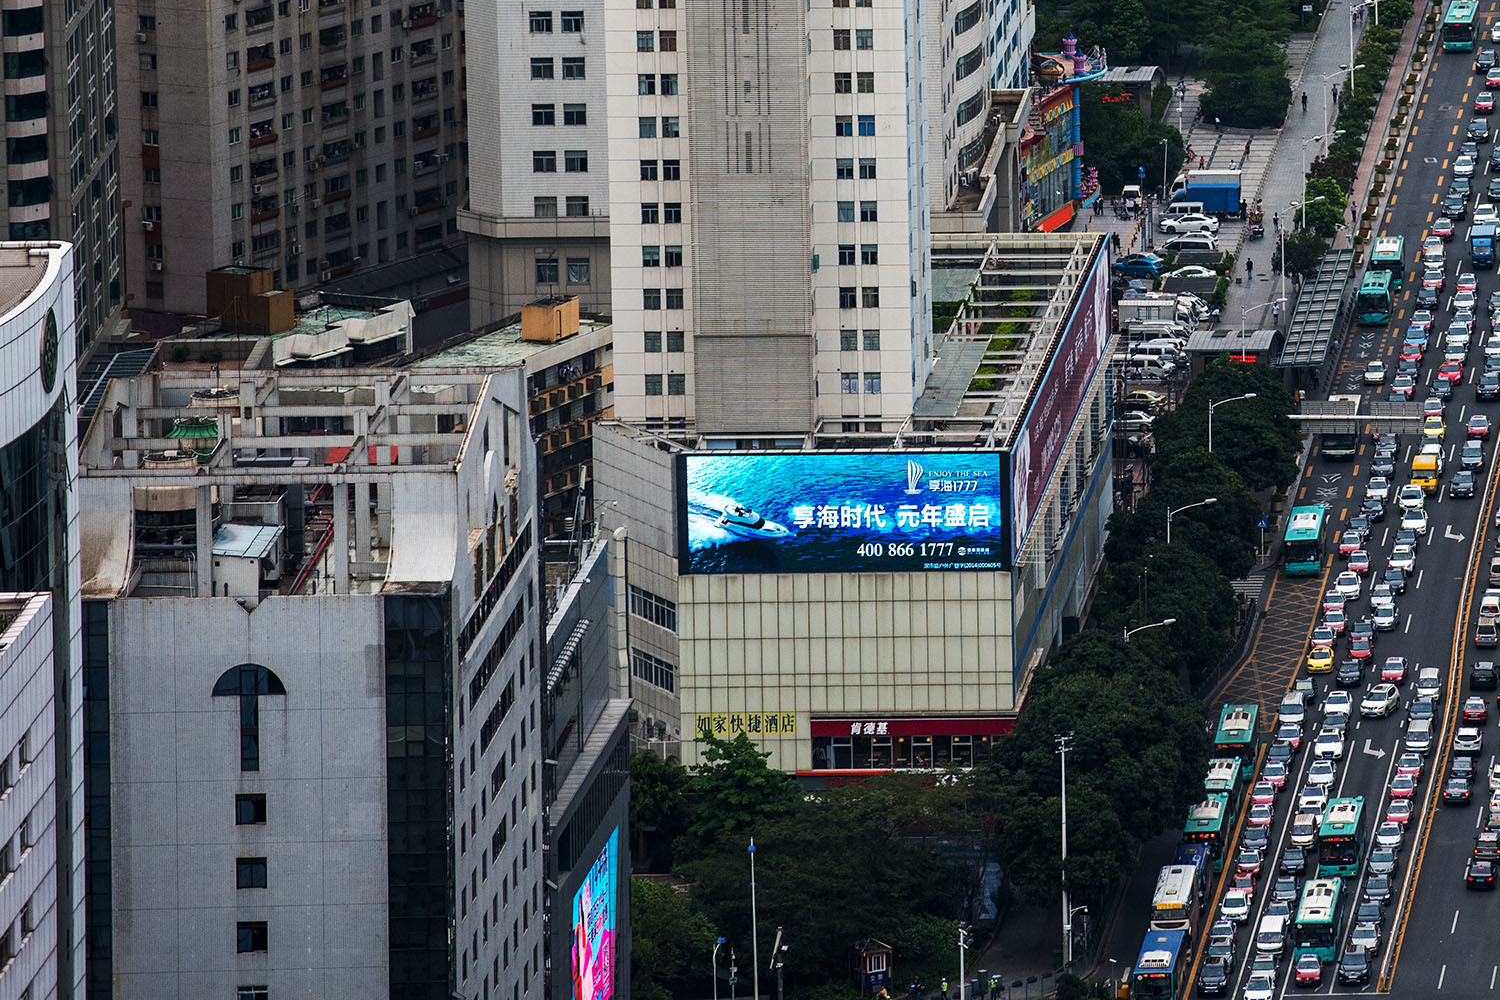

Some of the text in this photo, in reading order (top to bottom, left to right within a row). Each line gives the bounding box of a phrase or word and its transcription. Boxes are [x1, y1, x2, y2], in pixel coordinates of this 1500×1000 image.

[928, 480, 978, 492] 享海1777
[793, 503, 990, 529] 享海时代 元年盛启
[857, 543, 883, 557] 400
[888, 543, 914, 557] 866
[920, 543, 953, 557] 1777
[697, 714, 796, 734] 如家快捷酒店
[850, 722, 888, 735] 肯德基
